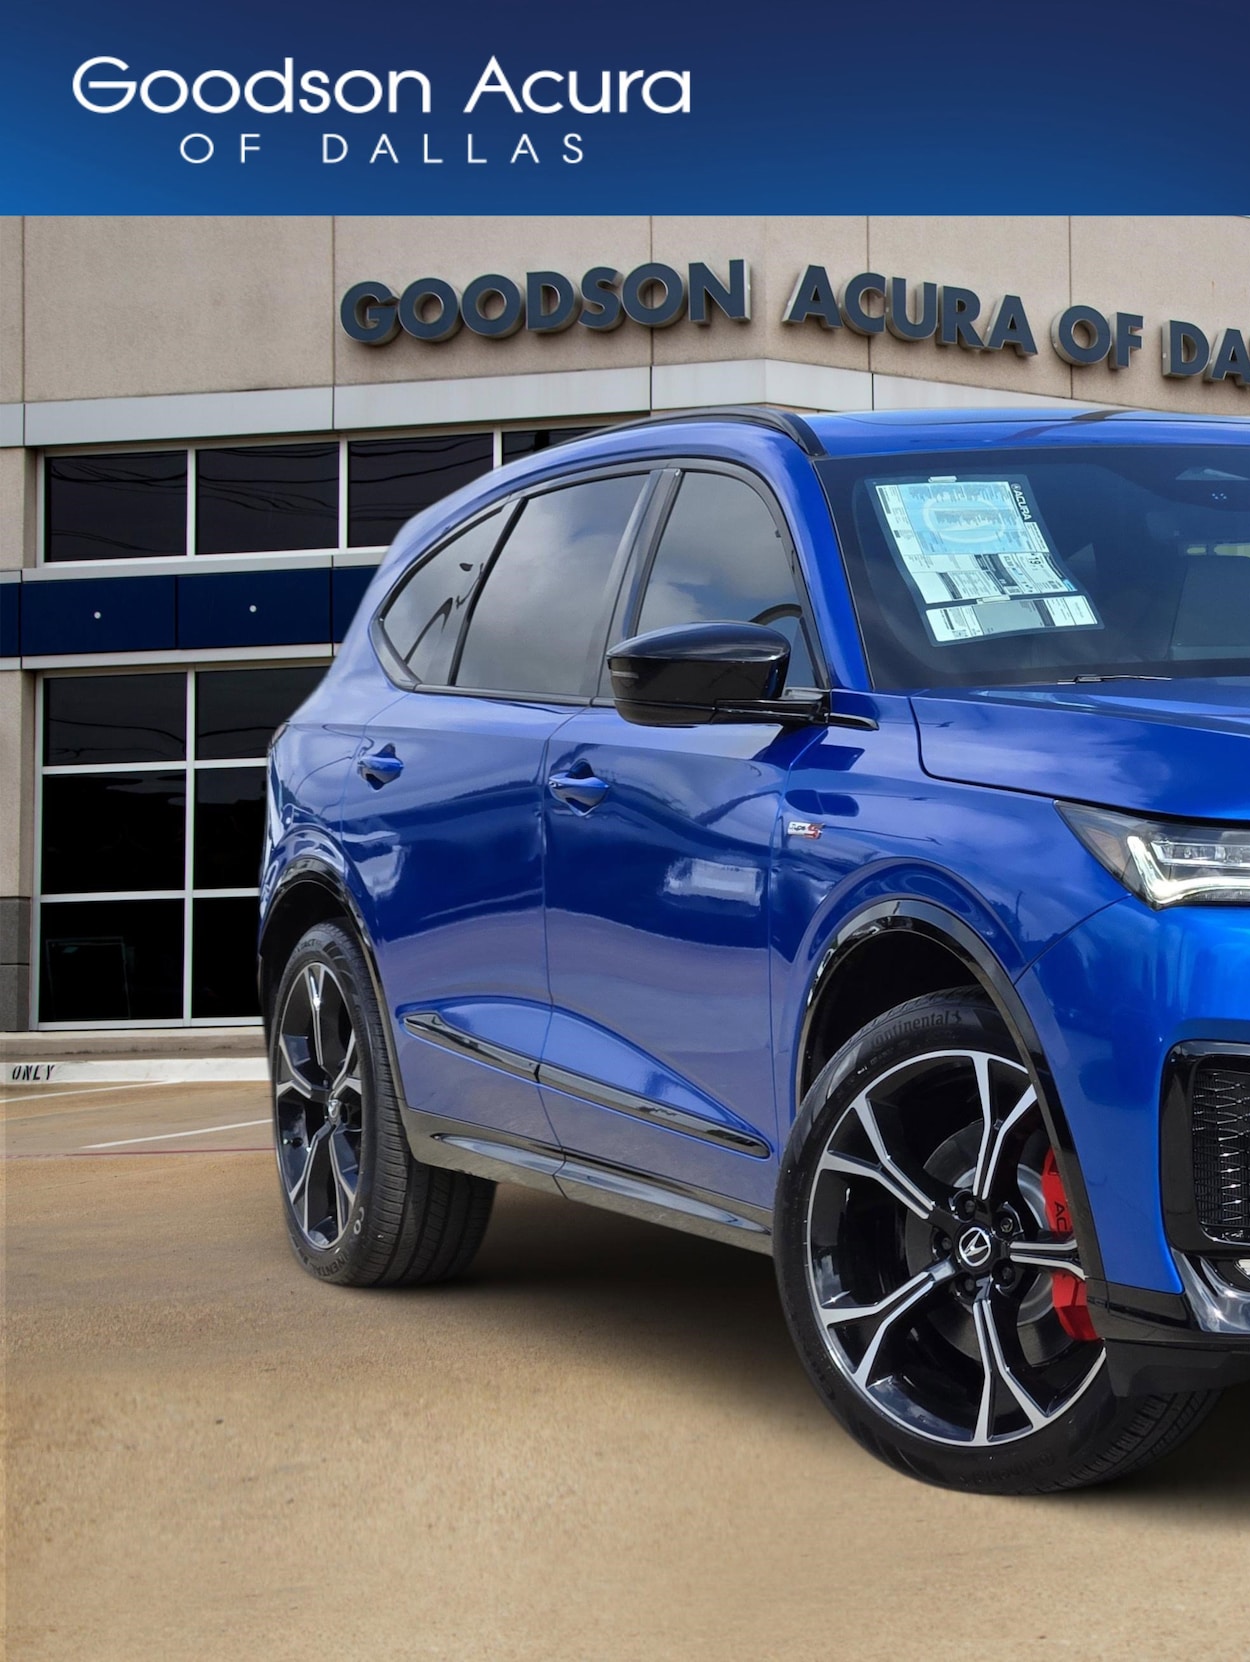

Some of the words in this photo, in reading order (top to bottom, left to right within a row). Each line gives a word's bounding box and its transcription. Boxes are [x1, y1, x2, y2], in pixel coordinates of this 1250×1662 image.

[340, 259, 751, 346] GOODSON
[782, 264, 1038, 356] ACURA
[1051, 305, 1144, 370] OF
[1013, 489, 1032, 521] ACURA
[11, 1064, 56, 1081] ONLY
